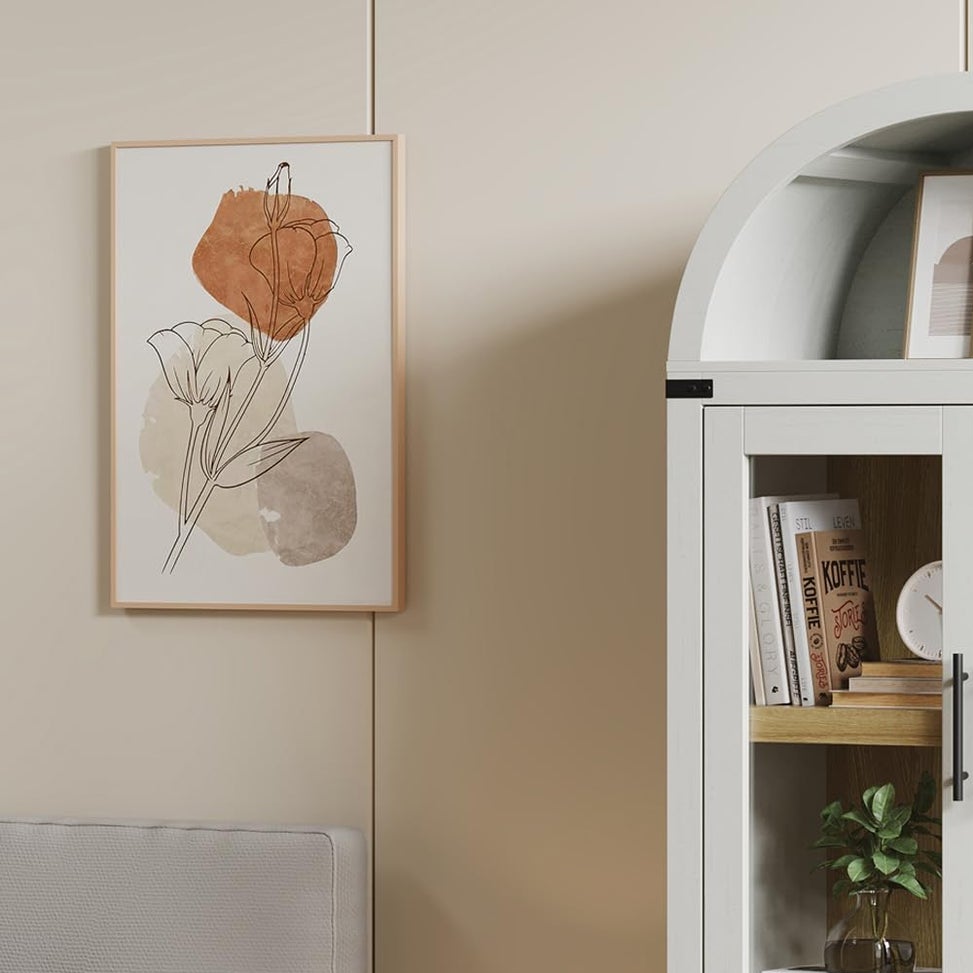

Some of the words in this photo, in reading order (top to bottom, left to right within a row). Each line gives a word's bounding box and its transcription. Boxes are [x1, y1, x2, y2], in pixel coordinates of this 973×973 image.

[795, 517, 812, 530] STIL
[832, 512, 856, 529] LEVEN
[821, 559, 870, 595] KOFFIE
[802, 576, 821, 629] KOFFIE
